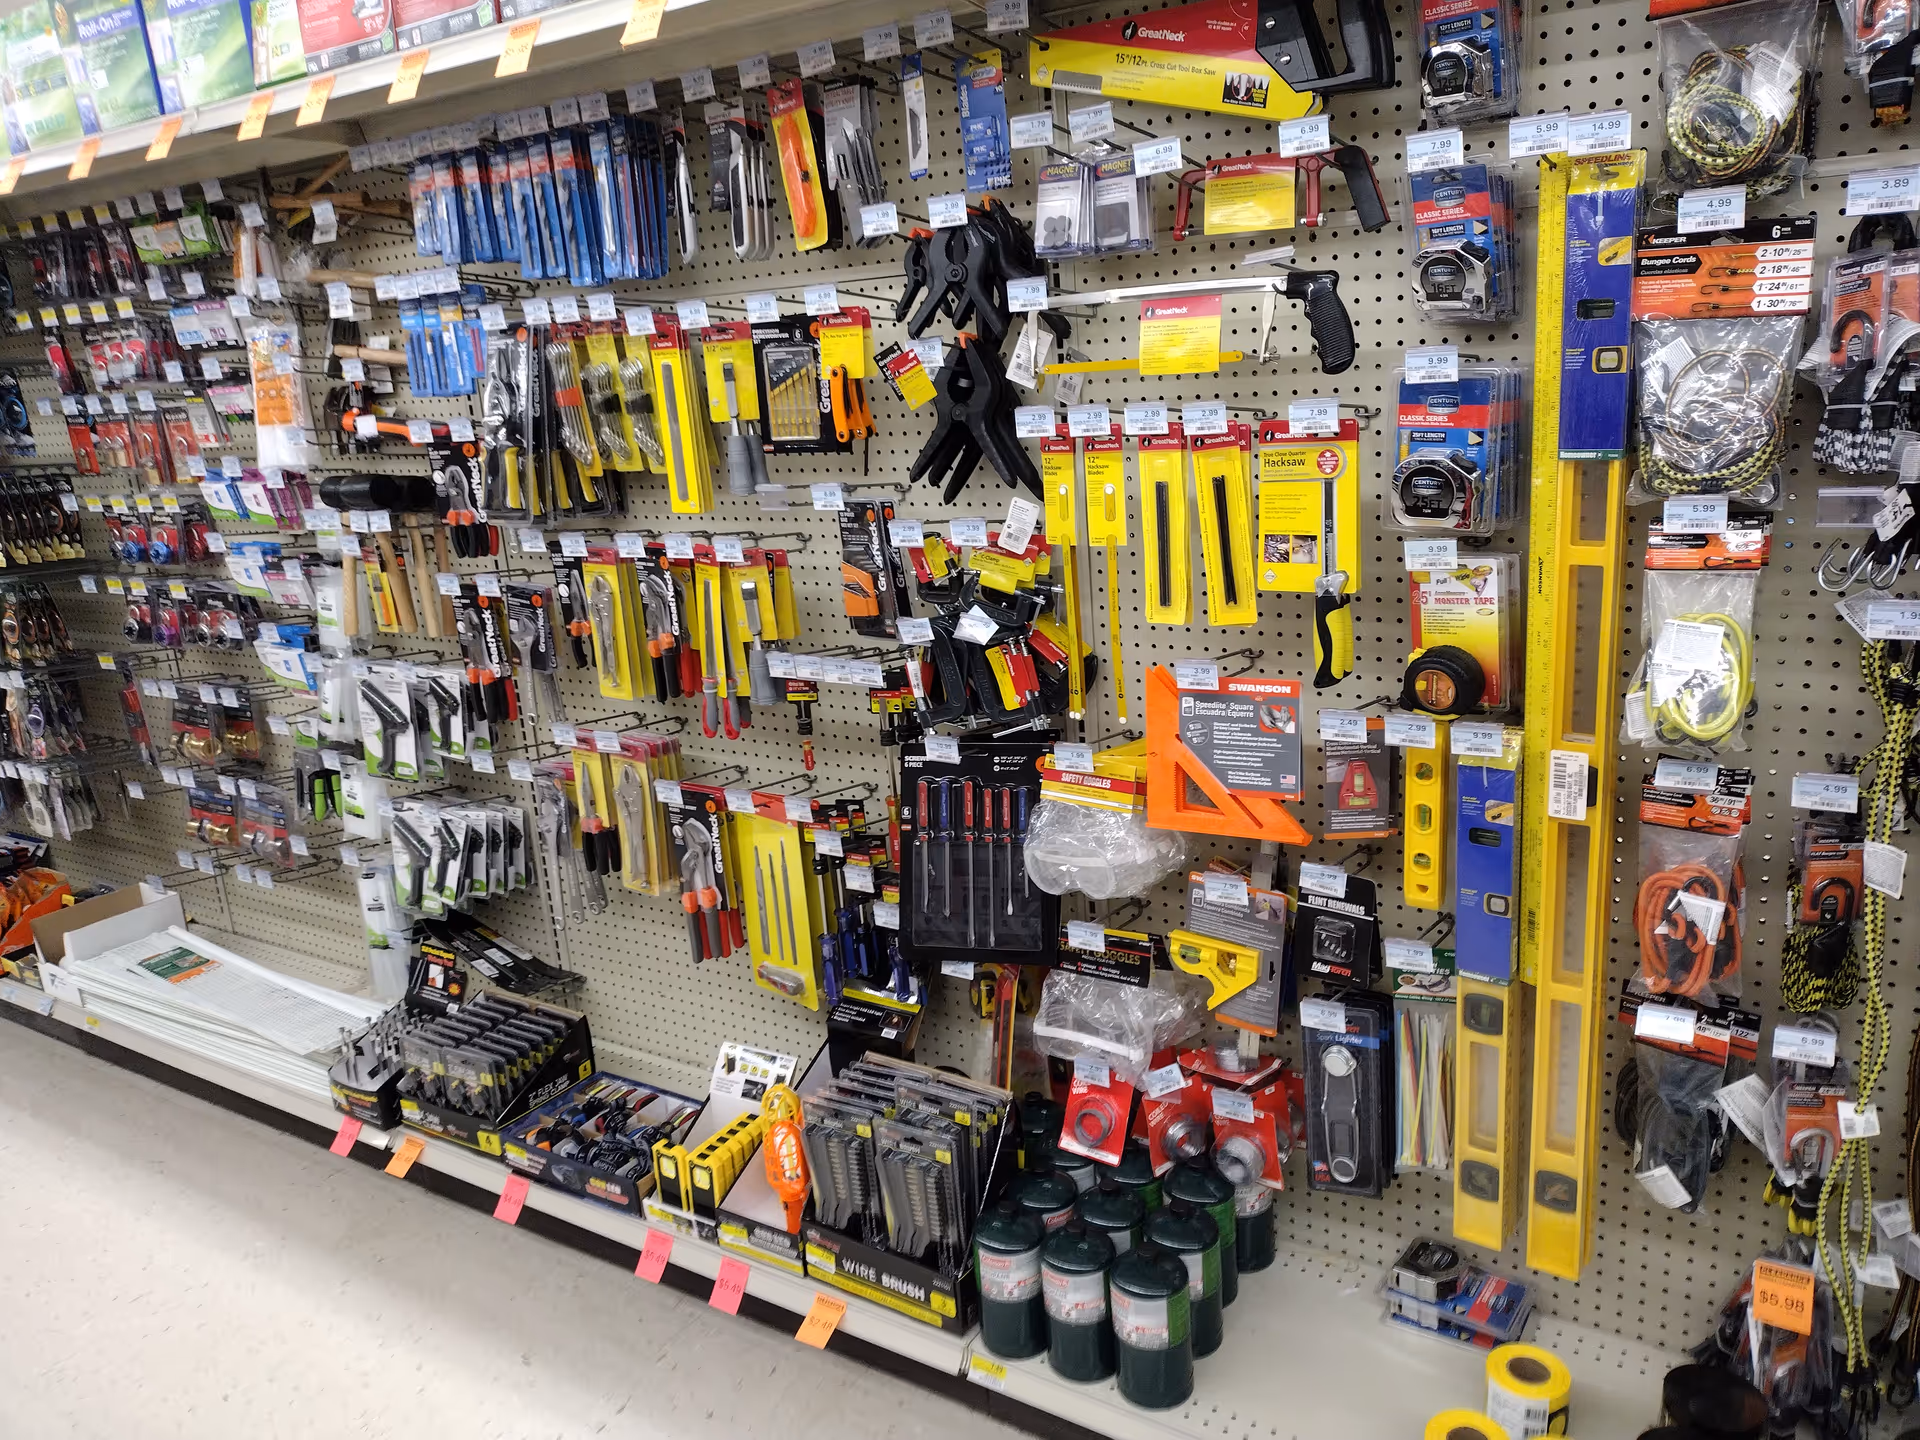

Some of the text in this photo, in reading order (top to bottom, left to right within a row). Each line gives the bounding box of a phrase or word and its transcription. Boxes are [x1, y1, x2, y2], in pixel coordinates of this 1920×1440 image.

[1004, 2, 1021, 11] 9.99
[1425, 0, 1473, 16] CLASSIC SERIES
[929, 17, 945, 26] 1.99
[1451, 20, 1471, 30] LENGTH
[878, 31, 893, 40] 1.99
[1138, 26, 1185, 42] GreatNeck
[1150, 60, 1166, 70] Cross
[1167, 63, 1177, 71] Cut
[1178, 64, 1191, 72] Tool
[1203, 67, 1217, 76] Saw
[961, 84, 970, 118] Blades
[1087, 110, 1103, 120] 1.99
[1030, 121, 1046, 129] 1.79
[1300, 124, 1319, 135] 6.99
[1536, 123, 1559, 134] 5.99
[1592, 120, 1621, 132] 14.99
[1431, 139, 1452, 150] 7.99
[1155, 145, 1173, 155] 6.99
[1101, 158, 1132, 171] MAGNET
[1222, 163, 1253, 172] GreatNeck
[1047, 165, 1080, 176] MAGNET
[1881, 178, 1910, 190] 3.89
[1435, 189, 1464, 198] CENTURY
[1707, 198, 1732, 209] 4.99
[877, 211, 890, 219] 1.99
[1416, 207, 1464, 220] CLASSIC SERIES
[1772, 225, 1780, 238] 6
[1652, 236, 1687, 245] KEEPER
[1641, 255, 1697, 266] Bungee Cords
[1431, 282, 1456, 294] 16FT
[1155, 305, 1187, 315] GreatNeck
[922, 344, 936, 352] 3.99
[1428, 356, 1449, 365] 9.99
[1087, 412, 1103, 420] 2.99
[1202, 409, 1218, 417] 2.99
[1310, 408, 1328, 416] 7.99
[1205, 435, 1236, 445] GreatNeck
[1264, 458, 1306, 468] Hacksaw
[467, 456, 487, 523] GreatNeck
[1412, 496, 1443, 508] 25FT
[1692, 504, 1716, 513] 5.99
[1428, 545, 1448, 553] 9.99
[1436, 578, 1447, 586] Full
[664, 570, 680, 636] GreatNeck
[1434, 597, 1495, 605] MONSTER TAPE
[538, 607, 546, 653] GreatNeck
[1194, 667, 1211, 675] 3.99
[1228, 683, 1291, 694] SWANSON
[1195, 701, 1254, 712] Speedlite Square
[1408, 723, 1426, 732] 2.99
[1473, 731, 1493, 739] 9.99
[1061, 772, 1111, 789] SAFETY GOGGLES
[1823, 785, 1848, 794] 4.99
[708, 813, 724, 874] GreatNeck
[1308, 895, 1365, 915] FLINT RENEWALS
[1084, 930, 1098, 938] 1.99
[1335, 1034, 1362, 1045] Lighter
[1801, 1036, 1825, 1046] 6.99
[1072, 1086, 1088, 1094] WIRE
[841, 1256, 925, 1302] WIRE BRUSH
[1759, 1288, 1805, 1313] $5.98
